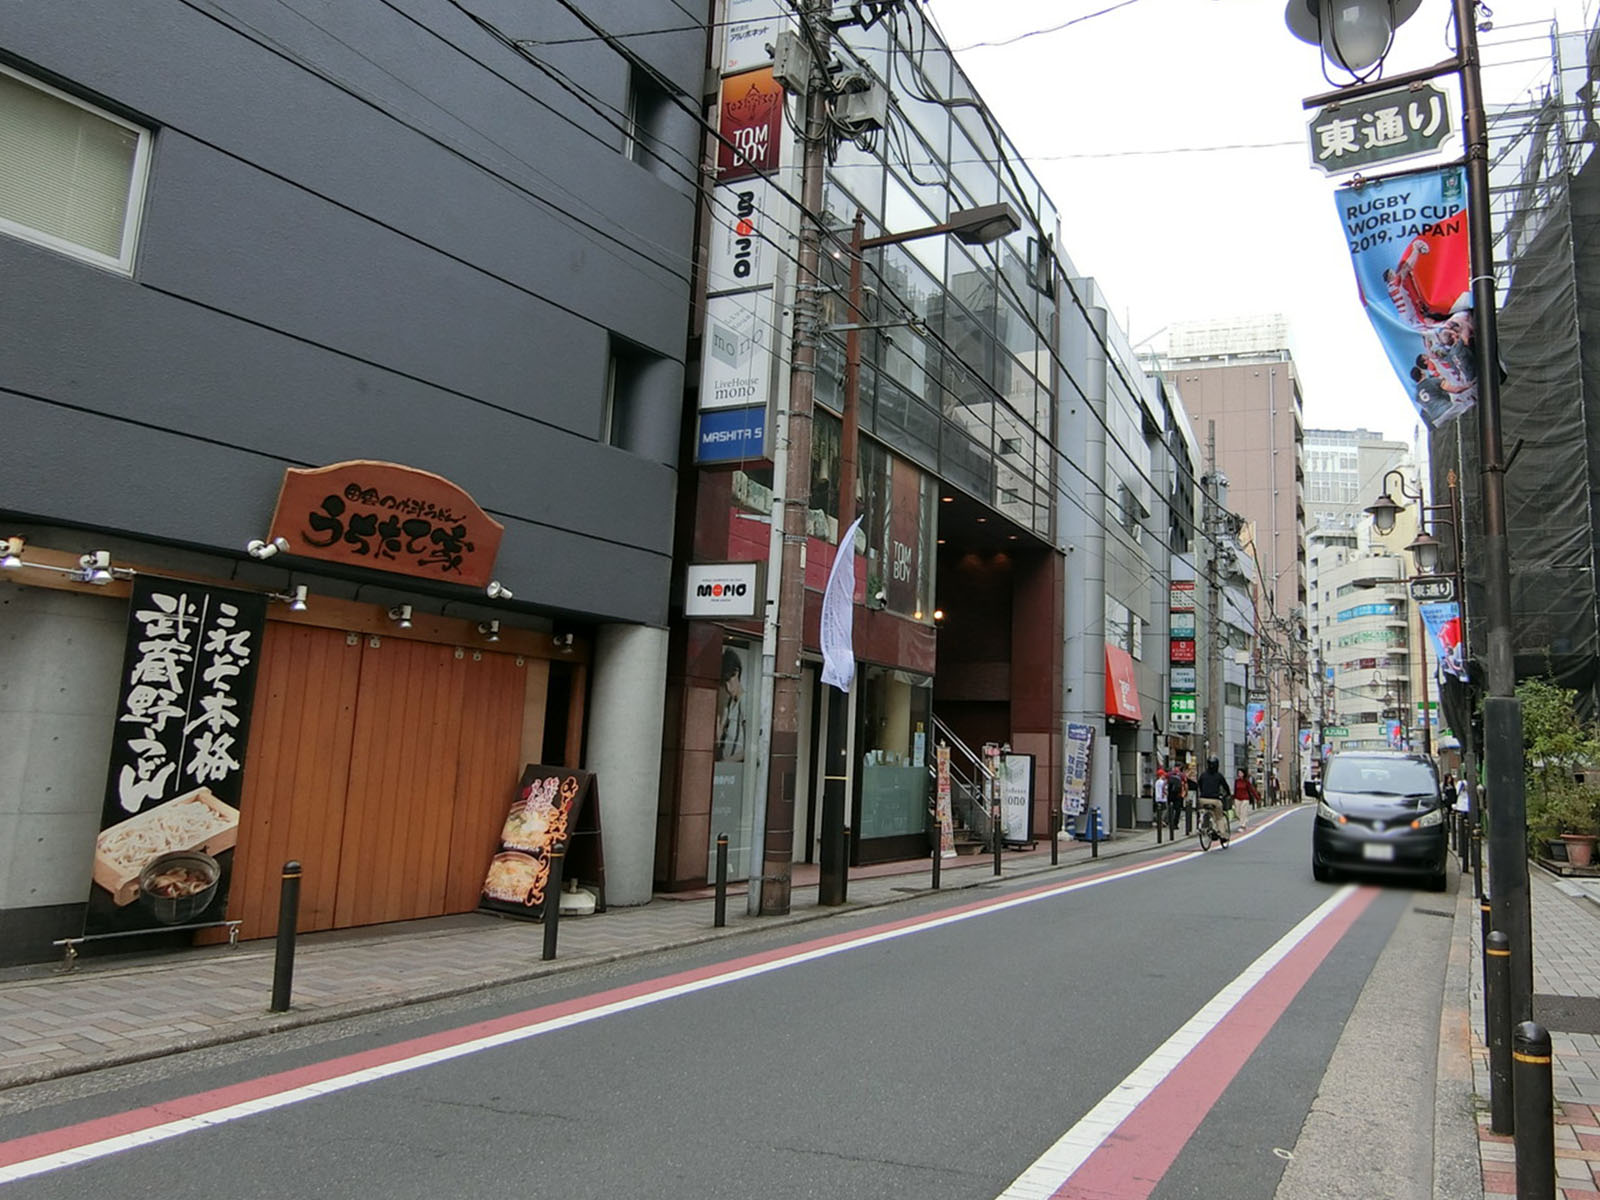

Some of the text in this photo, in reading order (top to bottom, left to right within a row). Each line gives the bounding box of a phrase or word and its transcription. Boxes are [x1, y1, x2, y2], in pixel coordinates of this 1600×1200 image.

[733, 123, 769, 149] TOM
[1315, 96, 1442, 161] 東通り
[733, 143, 768, 167] BOY
[1346, 192, 1411, 221] RUGBY
[1348, 203, 1460, 237] WORLD CUP
[1350, 221, 1461, 254] 2019, JAPAN
[715, 385, 756, 400] mono
[702, 429, 752, 443] MASHITA
[301, 494, 475, 575] うちたて家
[893, 541, 912, 563] TOM
[893, 561, 912, 583] BOY
[118, 593, 199, 813] 武蔵野うどん
[183, 603, 251, 784] これぞ本格
